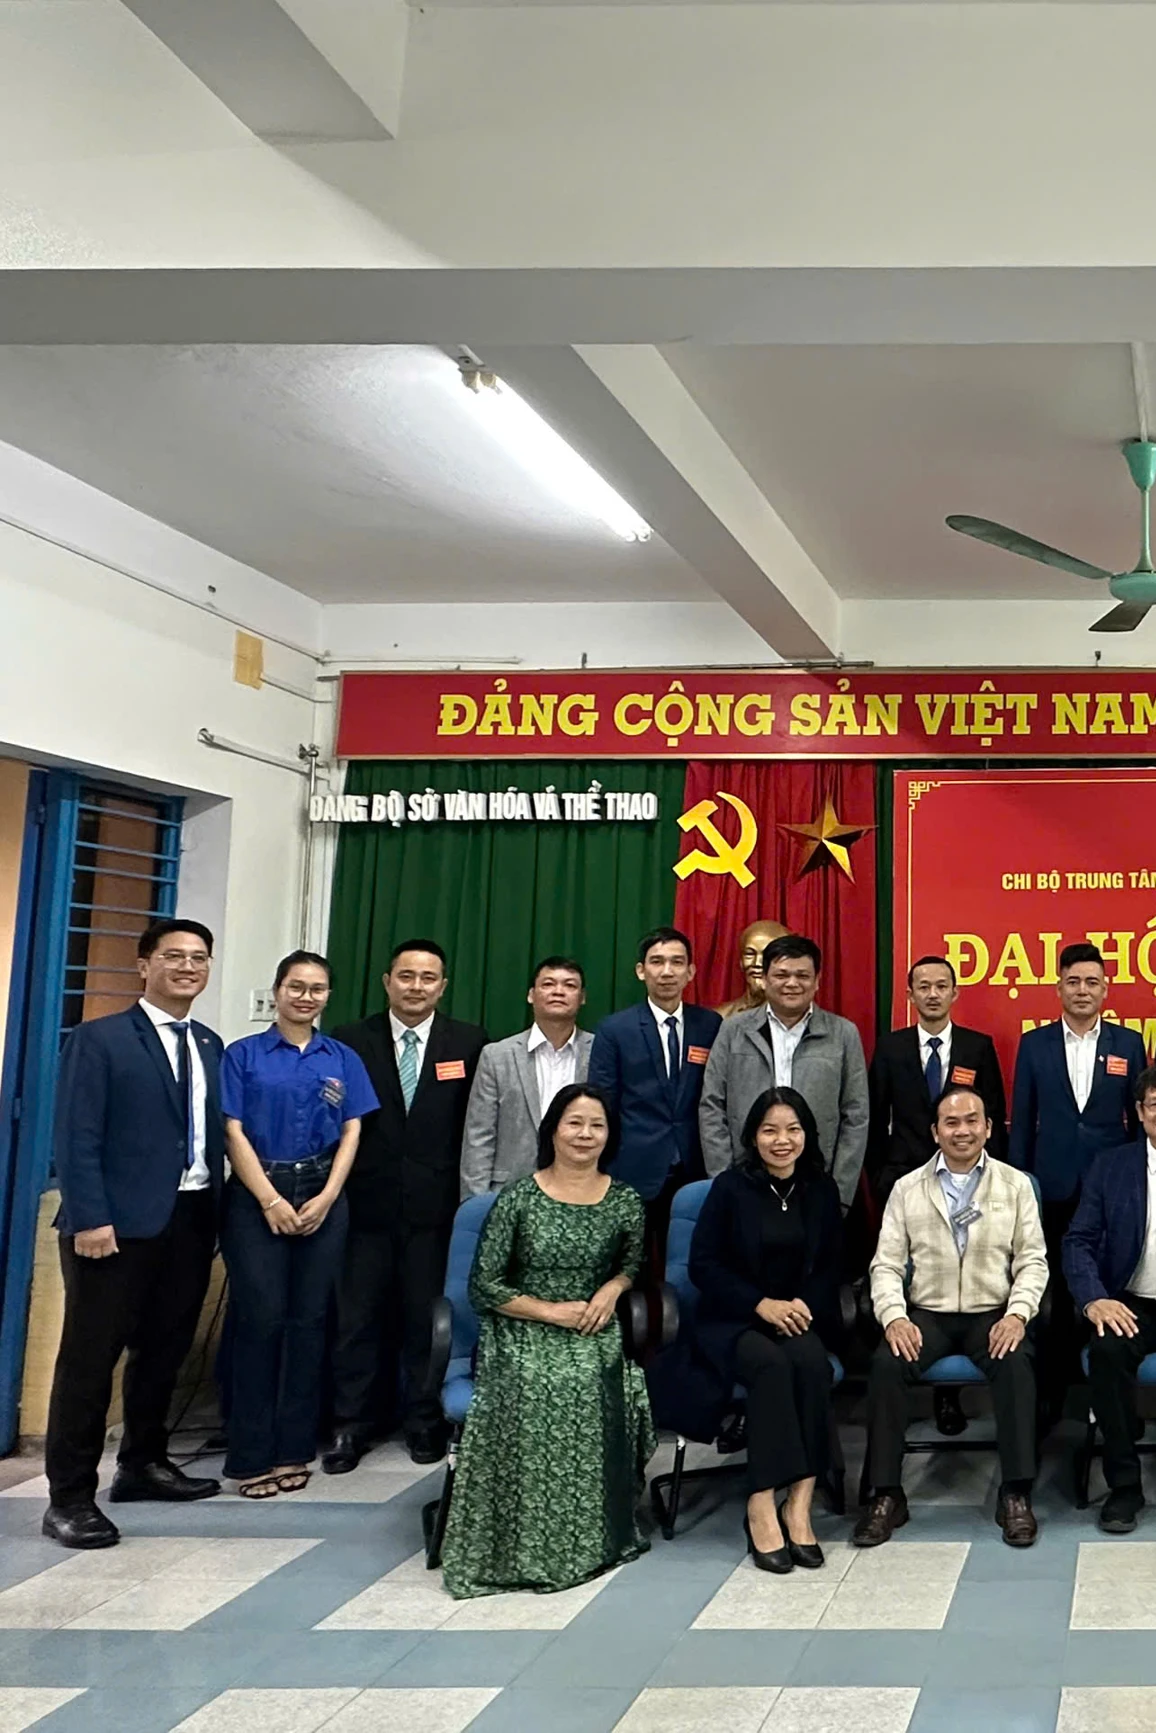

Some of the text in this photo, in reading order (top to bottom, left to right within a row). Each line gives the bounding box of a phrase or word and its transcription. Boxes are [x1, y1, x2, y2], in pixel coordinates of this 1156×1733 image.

[437, 678, 599, 736] ĐẢNG
[614, 680, 776, 747] CỘNG
[789, 678, 901, 736] SẢN
[915, 680, 1038, 746] VIỆT
[371, 790, 405, 828] BỘ
[407, 787, 441, 822] SỞ
[489, 786, 534, 820] HÓA
[604, 792, 659, 821] THAO
[1002, 873, 1031, 890] CHI
[1036, 869, 1060, 893] BỘ
[1065, 872, 1124, 889] TRUNG
[943, 932, 1063, 999] ĐẠI
